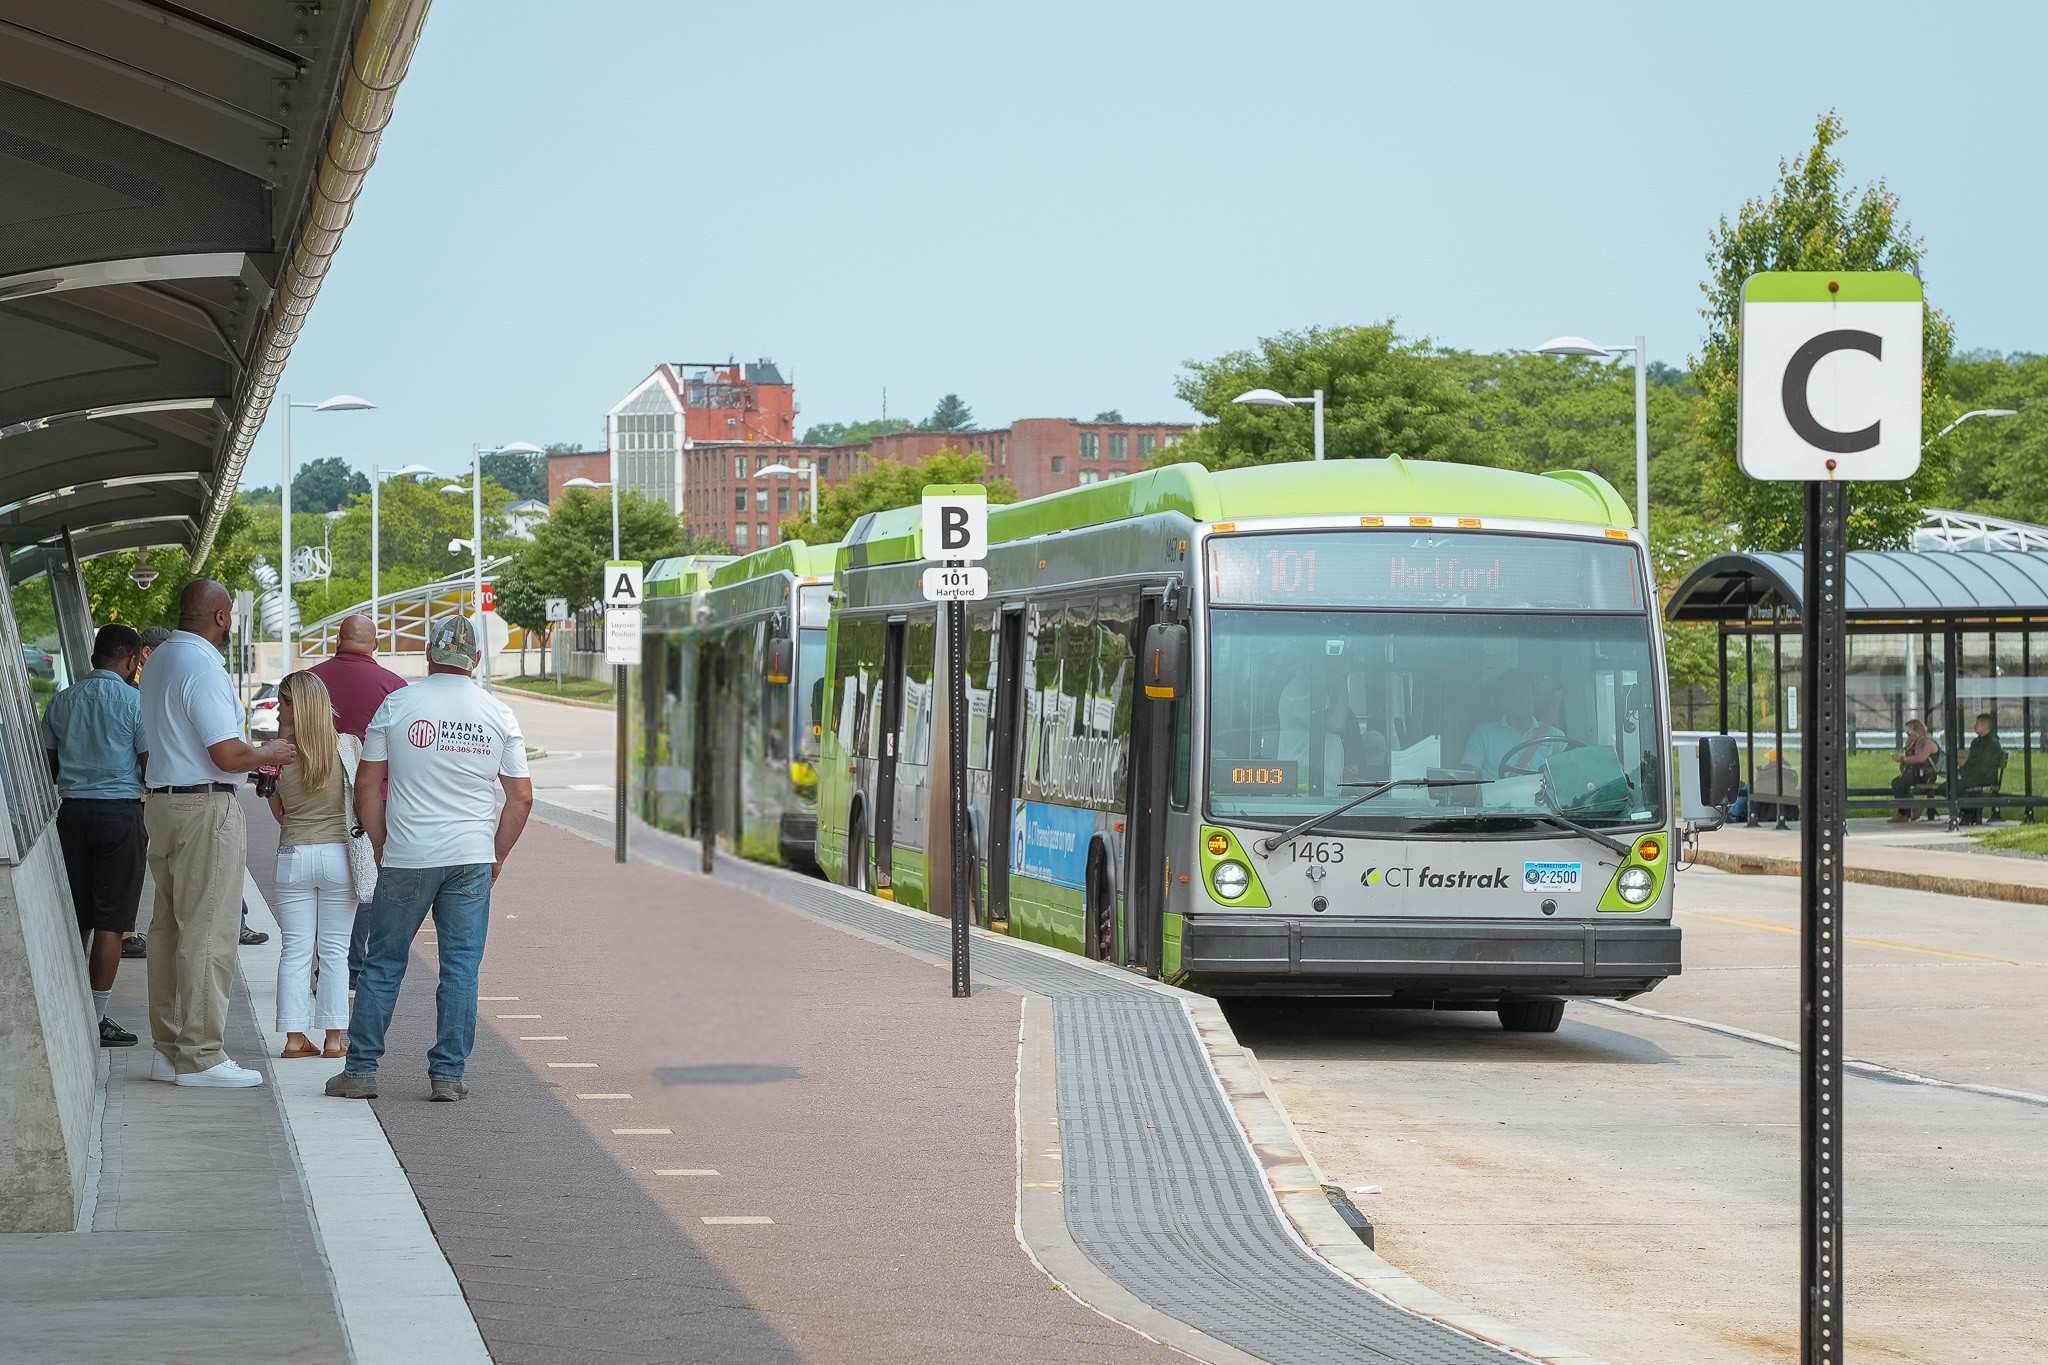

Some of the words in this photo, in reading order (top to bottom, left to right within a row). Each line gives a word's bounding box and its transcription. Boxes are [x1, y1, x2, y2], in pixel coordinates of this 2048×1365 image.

[1781, 328, 1883, 454] C
[941, 506, 971, 550] B
[1267, 550, 1316, 592] 101
[611, 572, 636, 598] A
[941, 573, 969, 586] 101
[936, 588, 975, 597] Hartford
[611, 621, 636, 631] Layover
[611, 630, 636, 638] Position
[442, 721, 483, 734] RYAN'S
[441, 731, 492, 744] MASONRY
[440, 744, 491, 756] 203-308-7810
[1232, 767, 1284, 784] 0103
[1288, 841, 1345, 864] 1463
[1418, 866, 1511, 889] fastrak
